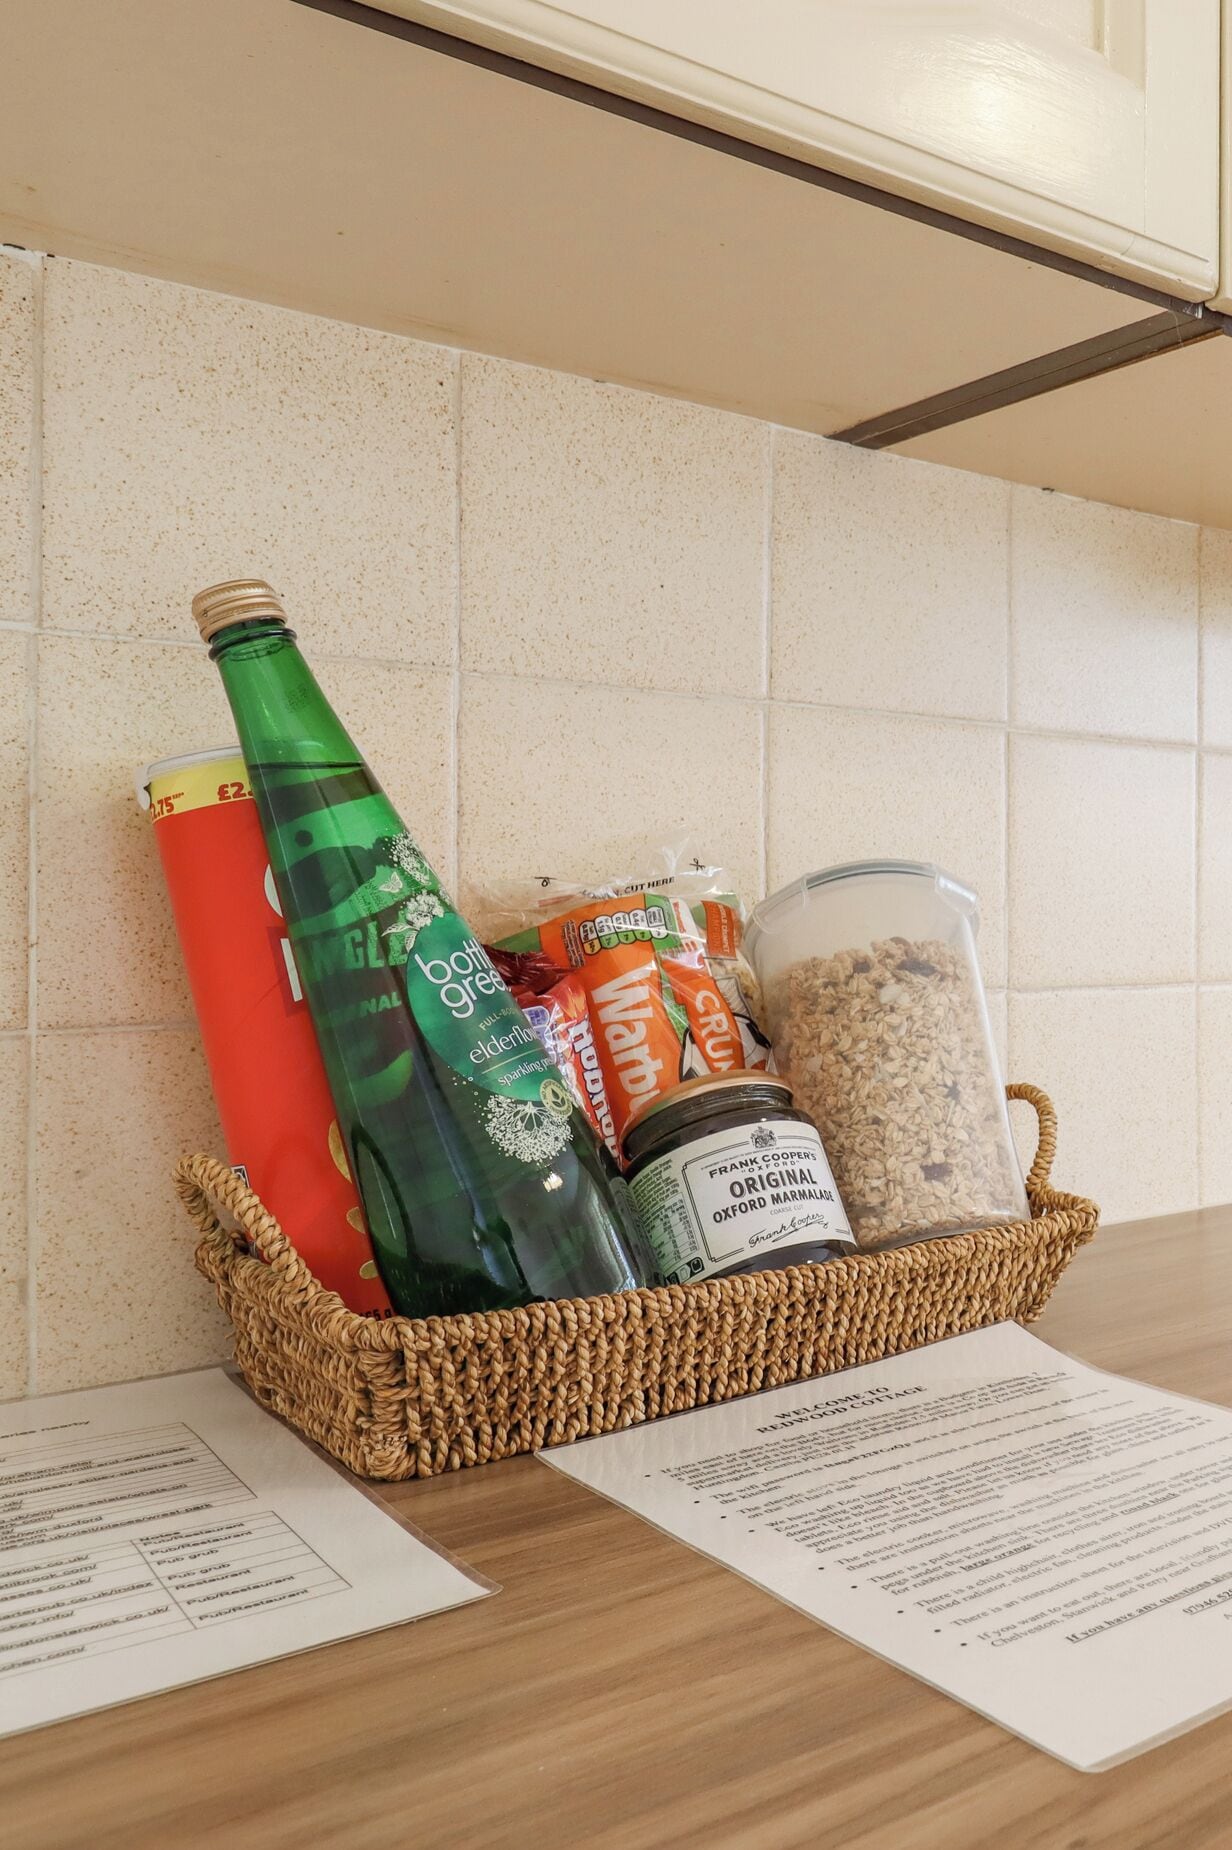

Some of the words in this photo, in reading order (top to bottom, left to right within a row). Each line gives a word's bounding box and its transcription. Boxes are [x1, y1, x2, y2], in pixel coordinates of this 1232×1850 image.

[647, 876, 675, 889] HERE
[440, 966, 512, 1019] gree
[498, 1062, 543, 1087] sparkling
[709, 1156, 758, 1179] FRANK
[762, 1151, 817, 1164] COOPER'S
[729, 1168, 818, 1199] ORIGINAL
[713, 1197, 767, 1224] OXFORD
[770, 1188, 835, 1205] MARMALADE
[769, 1206, 793, 1216] COARSE
[793, 1204, 804, 1212] CUT
[756, 1407, 848, 1433] REDWOOD
[850, 1385, 927, 1408] COTTAGE
[774, 1393, 865, 1418] WELCOME
[864, 1387, 889, 1395] TO
[860, 1486, 902, 1498] laundry
[150, 1530, 253, 1556] Pub/Restaurant
[156, 1556, 185, 1566] Pub
[188, 1548, 220, 1560] grub
[834, 1556, 861, 1564] The
[862, 1543, 905, 1556] electric
[867, 1569, 905, 1582] There
[975, 1530, 1021, 1546] washing
[912, 1571, 961, 1587] rubbish,
[959, 1558, 997, 1571] large
[994, 1543, 1036, 1560] orange
[1101, 1512, 1119, 1521] and
[167, 1571, 196, 1581] Pub
[199, 1562, 231, 1574] grub
[175, 1568, 252, 1590] Restaurant
[913, 1593, 952, 1606] There
[975, 1573, 1005, 1585] child
[1005, 1554, 1057, 1574] highchair,
[926, 1599, 961, 1613] filled
[962, 1582, 1011, 1601] radiator,
[1012, 1567, 1052, 1582] electric
[1076, 1542, 1122, 1558] cleaning
[950, 1611, 989, 1625] There
[1004, 1600, 1019, 1608] an
[1021, 1577, 1080, 1601] instruction
[1080, 1566, 1109, 1577] sheet
[1125, 1553, 1145, 1561] the
[1143, 1535, 1192, 1553] television
[186, 1575, 296, 1606] Pub/Restaurant
[198, 1588, 309, 1621] Pub/Restaurant
[977, 1632, 991, 1640] If
[992, 1624, 1017, 1636] you
[1018, 1611, 1048, 1624] want
[1063, 1599, 1081, 1607] eat
[1082, 1591, 1105, 1600] out,
[1103, 1579, 1133, 1591] there
[1134, 1572, 1151, 1580] are
[1149, 1560, 1182, 1573] local,
[1181, 1544, 1220, 1560] friendly
[990, 1619, 1064, 1646] Chelveston,
[1061, 1597, 1116, 1618] Stanwick
[1116, 1587, 1138, 1597] and
[1136, 1577, 1168, 1589] Perry
[1169, 1566, 1191, 1577] near
[1065, 1633, 1086, 1643] If
[1080, 1625, 1109, 1638] you
[1103, 1612, 1140, 1627] have
[1135, 1603, 1163, 1615] any
[1160, 1581, 1215, 1604] questions
